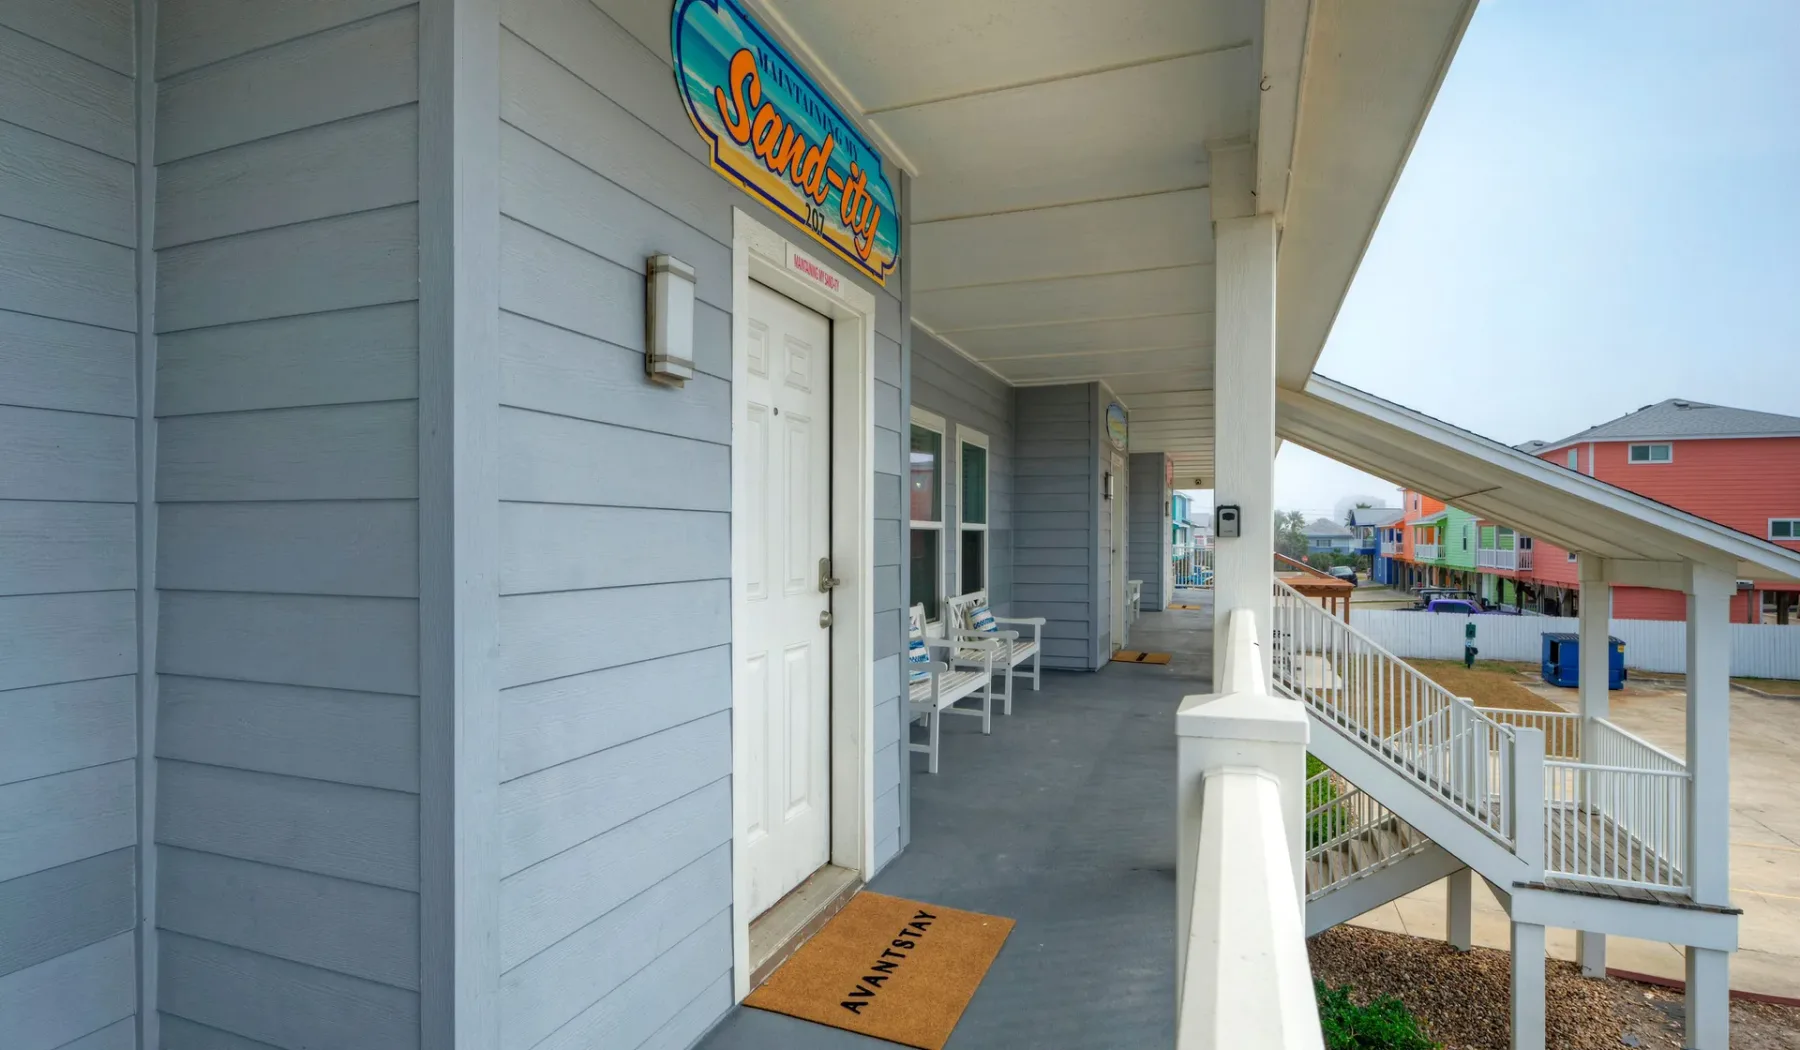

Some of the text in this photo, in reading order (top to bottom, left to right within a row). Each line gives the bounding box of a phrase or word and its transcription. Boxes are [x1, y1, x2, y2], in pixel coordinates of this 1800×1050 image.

[714, 48, 881, 261] Sand-ity
[757, 47, 858, 162] MAINTAINING MY
[805, 202, 825, 233] 207
[841, 909, 937, 1015] AVANTSTAY
